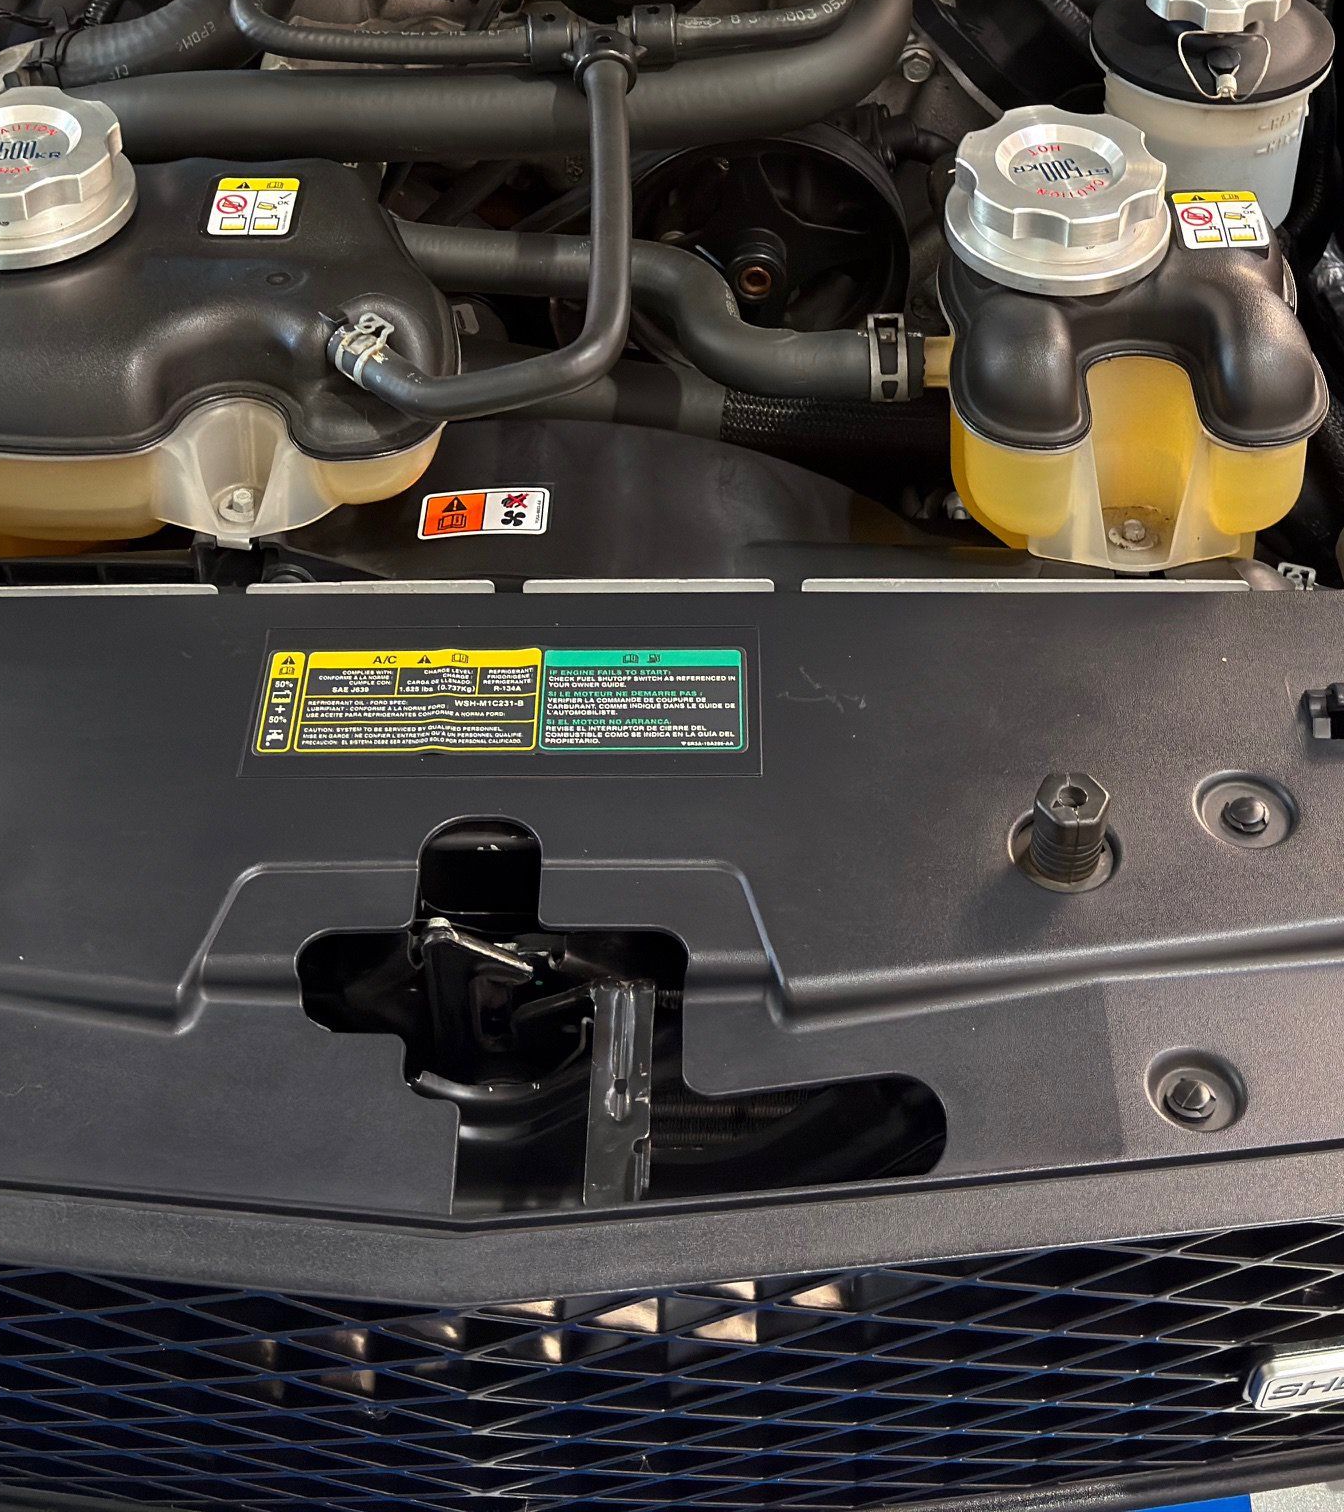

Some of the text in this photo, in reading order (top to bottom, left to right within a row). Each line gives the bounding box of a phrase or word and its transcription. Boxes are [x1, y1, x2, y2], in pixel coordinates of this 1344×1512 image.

[1013, 158, 1109, 182] GT500KR
[373, 655, 397, 664] A/C
[275, 680, 293, 688] 50%
